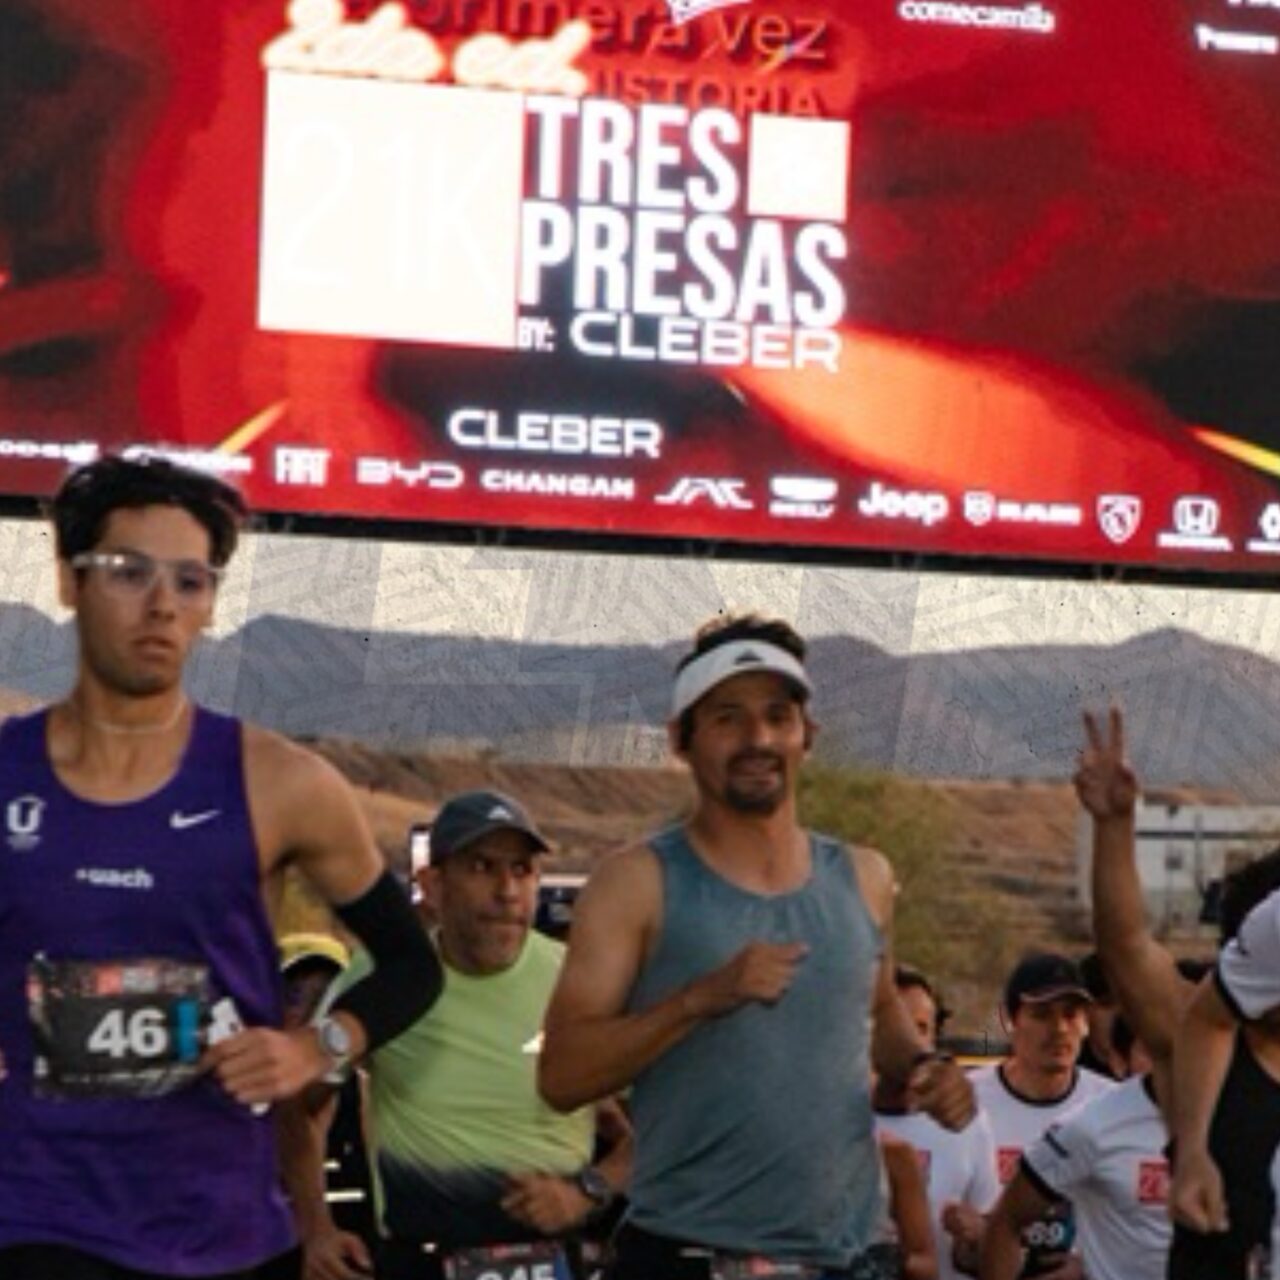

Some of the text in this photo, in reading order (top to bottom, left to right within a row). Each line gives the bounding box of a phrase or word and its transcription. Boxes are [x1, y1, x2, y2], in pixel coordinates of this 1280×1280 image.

[714, 12, 827, 60] vez
[590, 68, 826, 116] ISTORIA
[524, 95, 741, 214] TRES
[521, 201, 848, 328] PRESAS
[570, 311, 842, 373] CLEBER
[447, 408, 662, 459] CLEBER
[355, 456, 465, 490] BYD
[479, 468, 635, 500] CHANGAN
[858, 481, 949, 527] Jeep
[86, 1008, 170, 1059] 46
